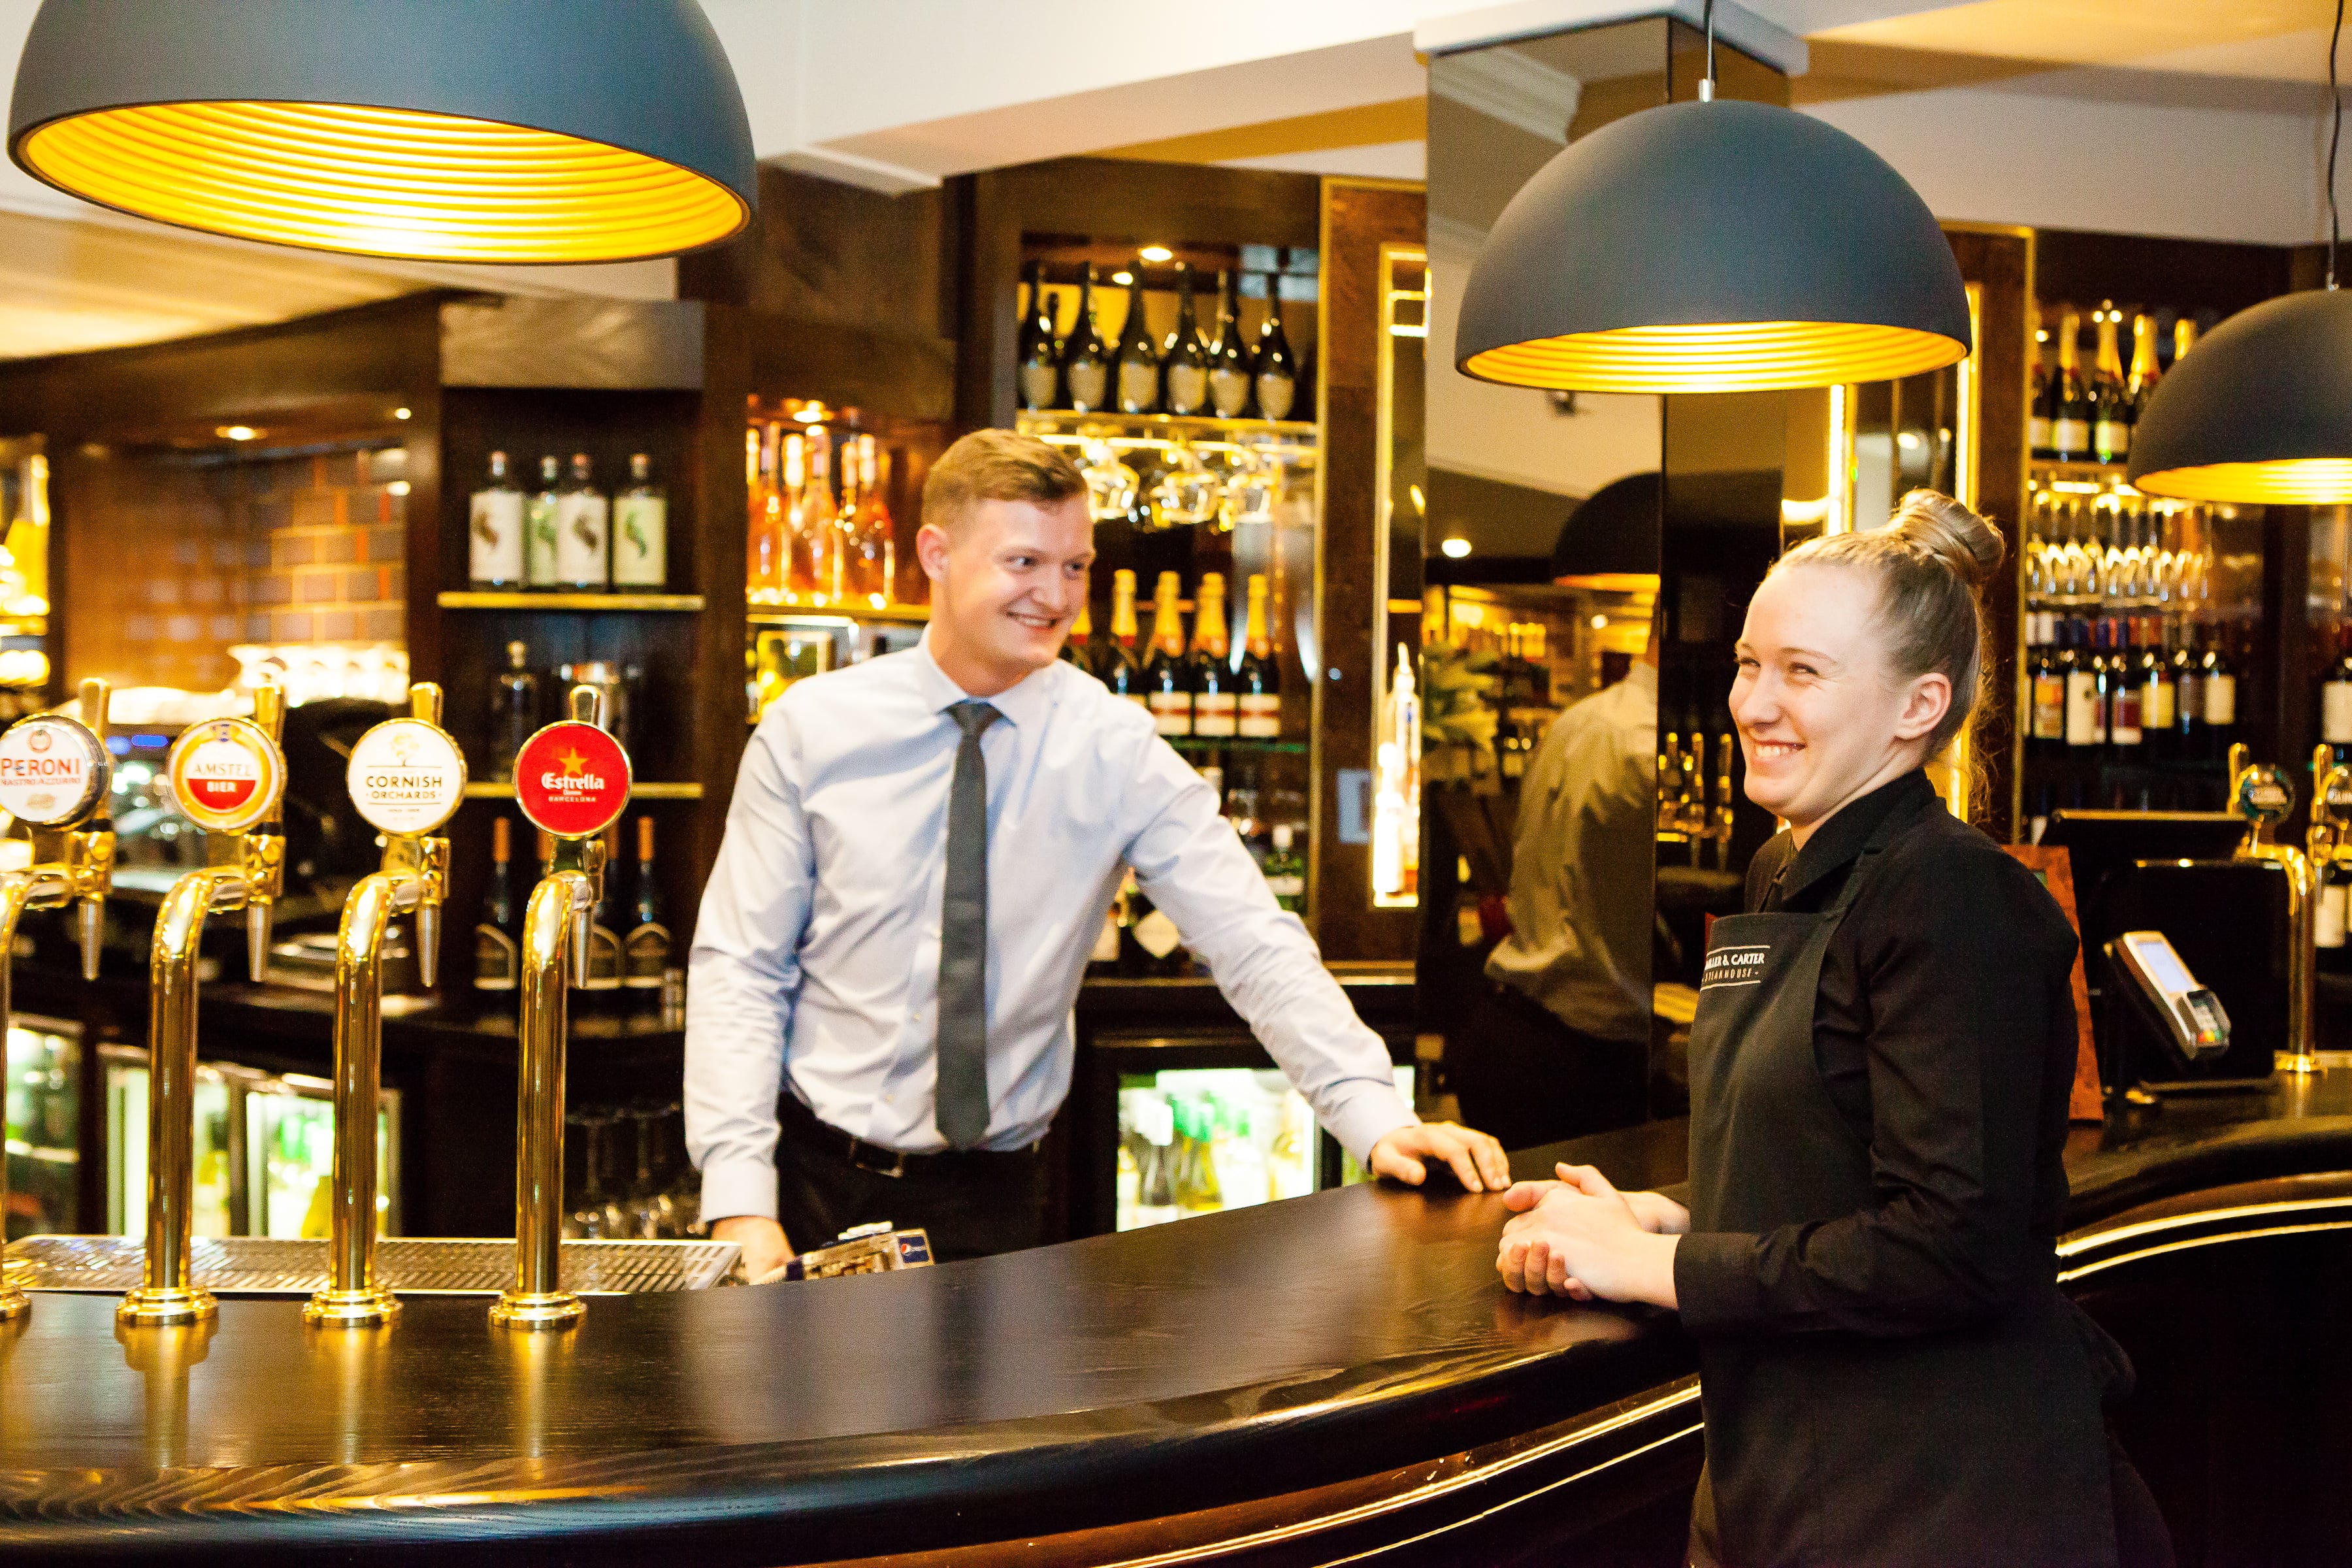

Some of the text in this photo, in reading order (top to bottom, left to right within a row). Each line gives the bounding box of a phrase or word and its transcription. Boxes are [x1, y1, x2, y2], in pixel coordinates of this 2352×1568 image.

[1, 758, 80, 776] PERONI
[195, 763, 252, 776] AMSTEL
[206, 781, 236, 792] BIER
[366, 776, 442, 788] CORNISH
[541, 772, 605, 790] Estrella
[371, 791, 436, 800] ORCHARDS
[1722, 954, 1730, 966] &
[1731, 953, 1765, 966] CARTER
